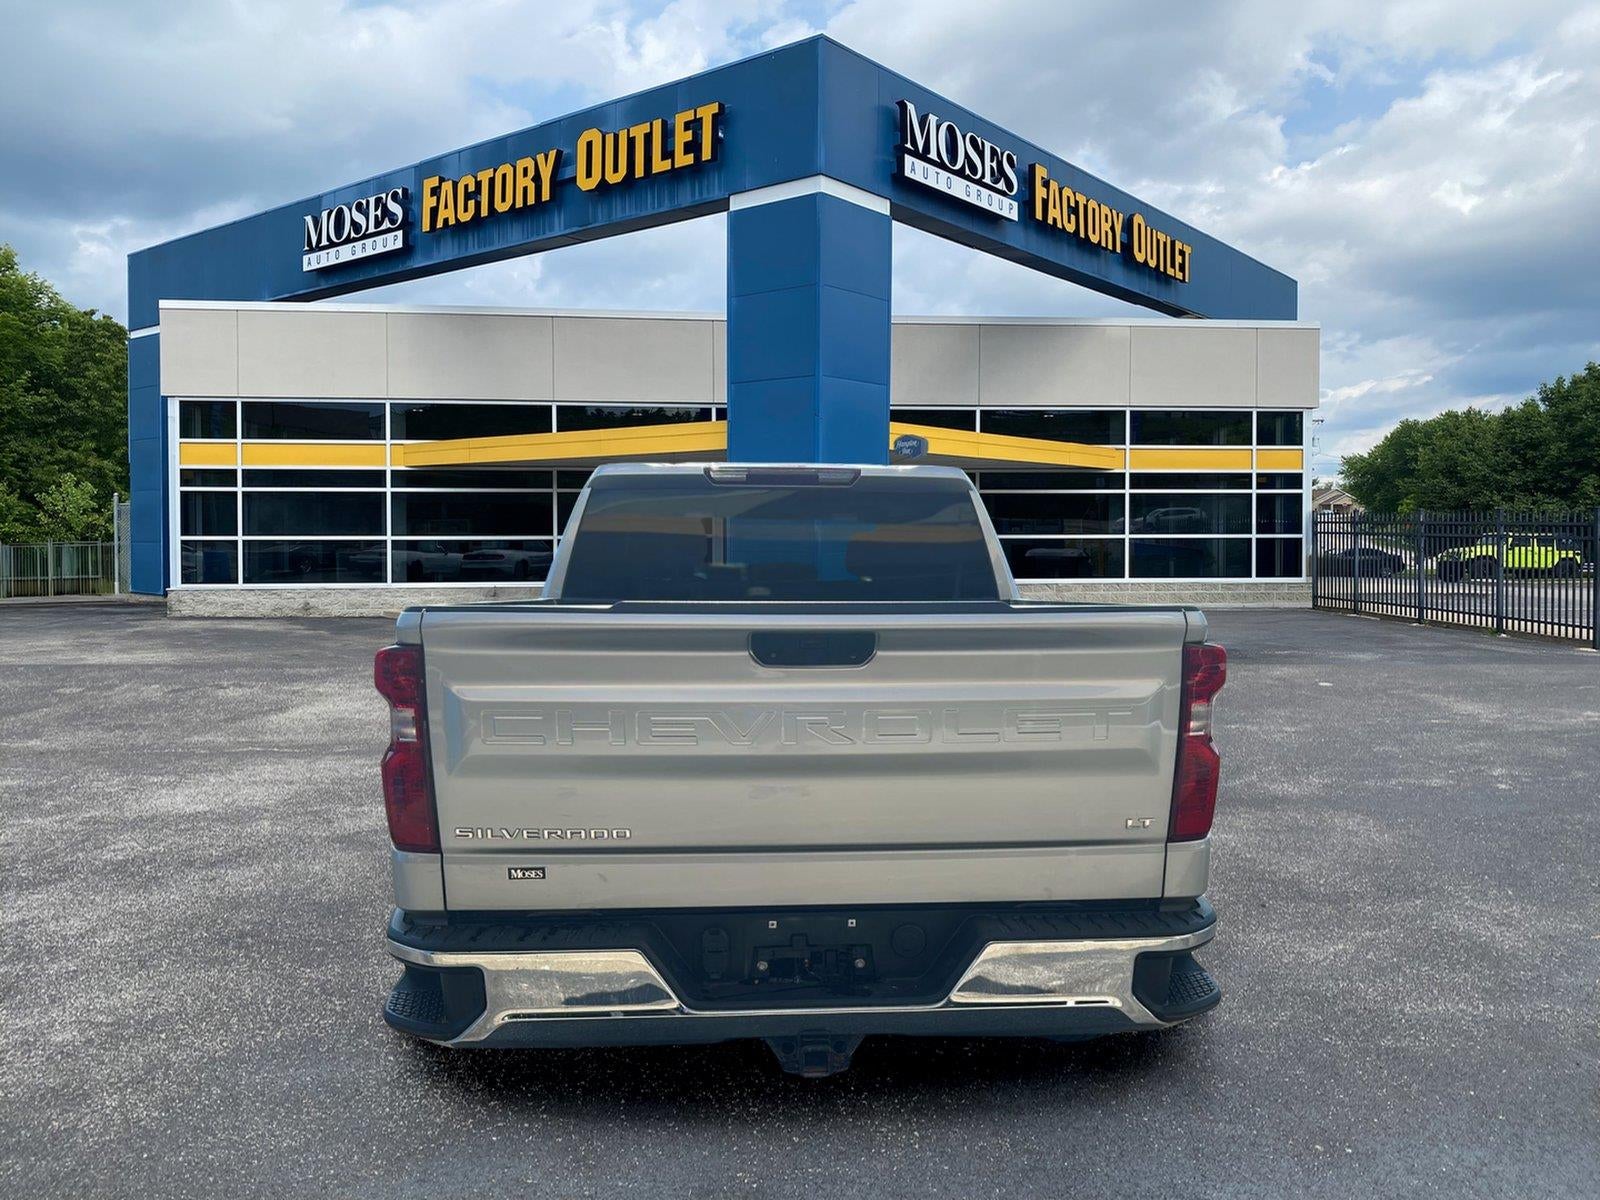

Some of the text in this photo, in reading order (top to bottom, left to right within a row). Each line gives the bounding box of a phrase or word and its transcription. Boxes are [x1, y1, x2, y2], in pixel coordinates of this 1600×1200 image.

[422, 101, 720, 233] FACTORY OUTLET
[903, 99, 1019, 196] MOSES
[909, 161, 1015, 215] AUTO GROUP
[303, 188, 404, 251] MOSES
[1034, 162, 1192, 283] FACTORY OUTLET
[307, 234, 399, 267] AUTO GROUP
[480, 706, 1134, 745] CHEVROLET
[454, 827, 632, 840] SILVERADO
[1125, 816, 1155, 829] LT
[510, 868, 544, 879] MOSES
